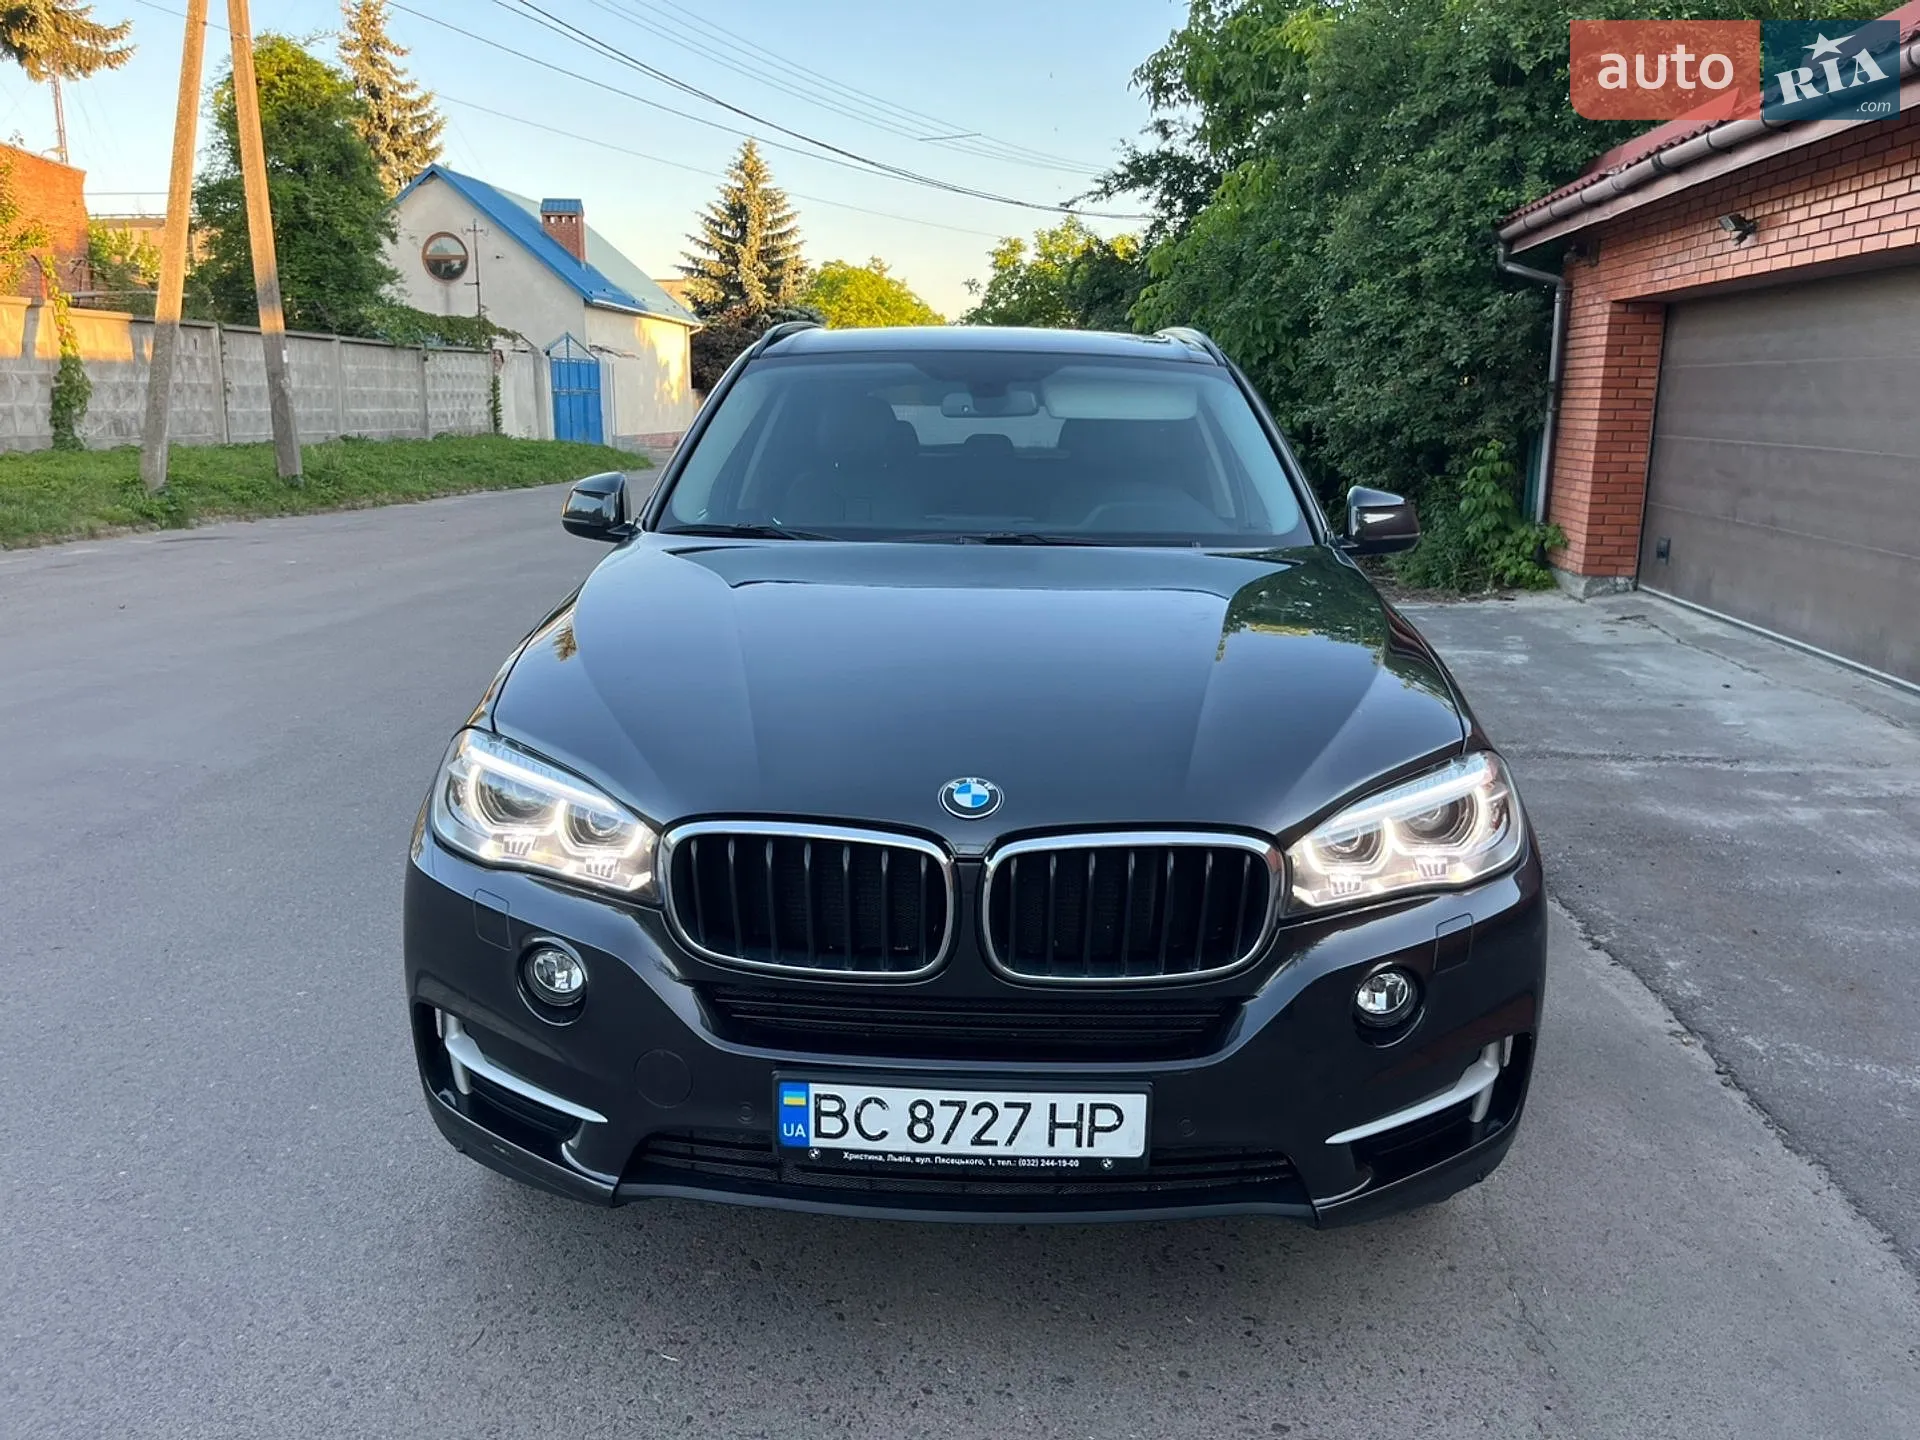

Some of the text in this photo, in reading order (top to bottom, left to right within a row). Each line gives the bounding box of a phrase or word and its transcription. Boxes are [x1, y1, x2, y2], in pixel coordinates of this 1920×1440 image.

[814, 1093, 1124, 1148] BC 8727 HP
[783, 1122, 806, 1137] UA
[1018, 1158, 1039, 1167] (032)
